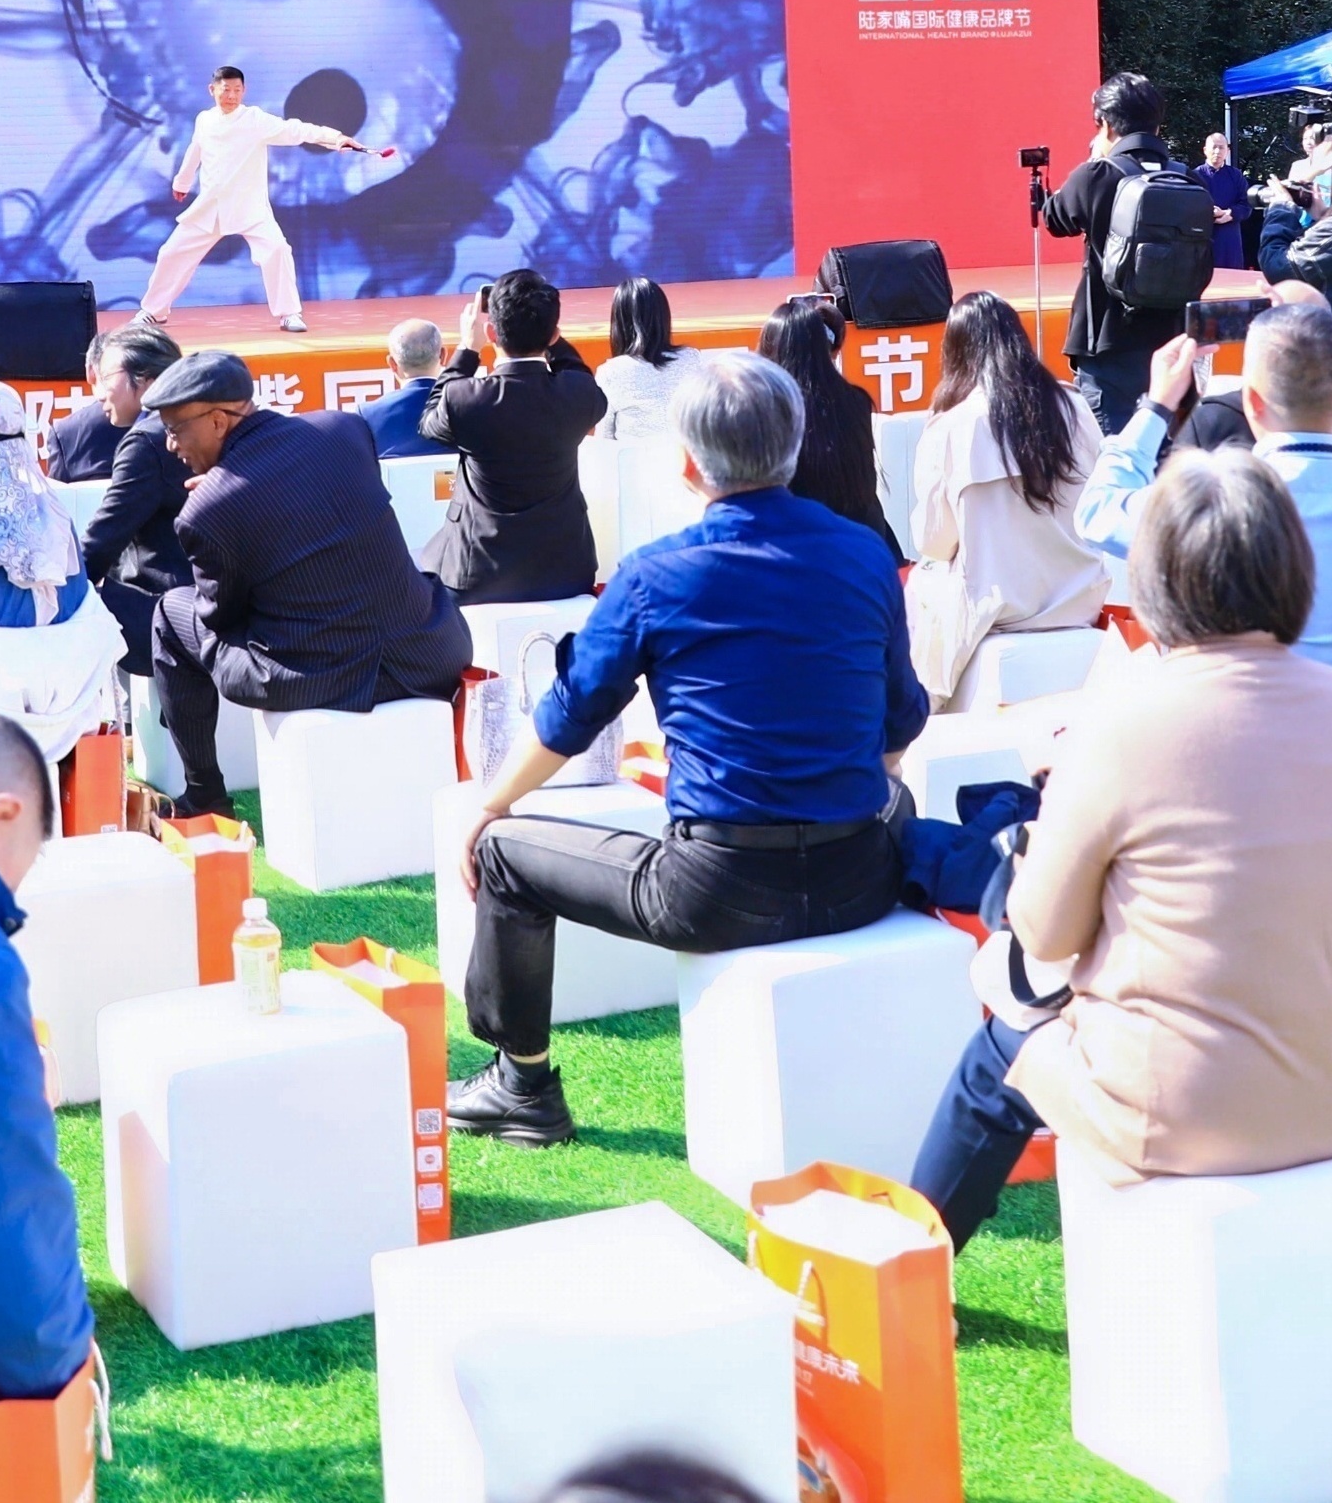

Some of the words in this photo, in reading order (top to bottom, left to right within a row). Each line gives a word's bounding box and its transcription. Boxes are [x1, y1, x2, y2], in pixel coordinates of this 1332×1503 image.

[858, 8, 1031, 29] 陆家嘴国际健康品牌节
[859, 32, 925, 41] INTERNATIONAL
[927, 31, 958, 39] HEALTH
[860, 334, 930, 414] 节
